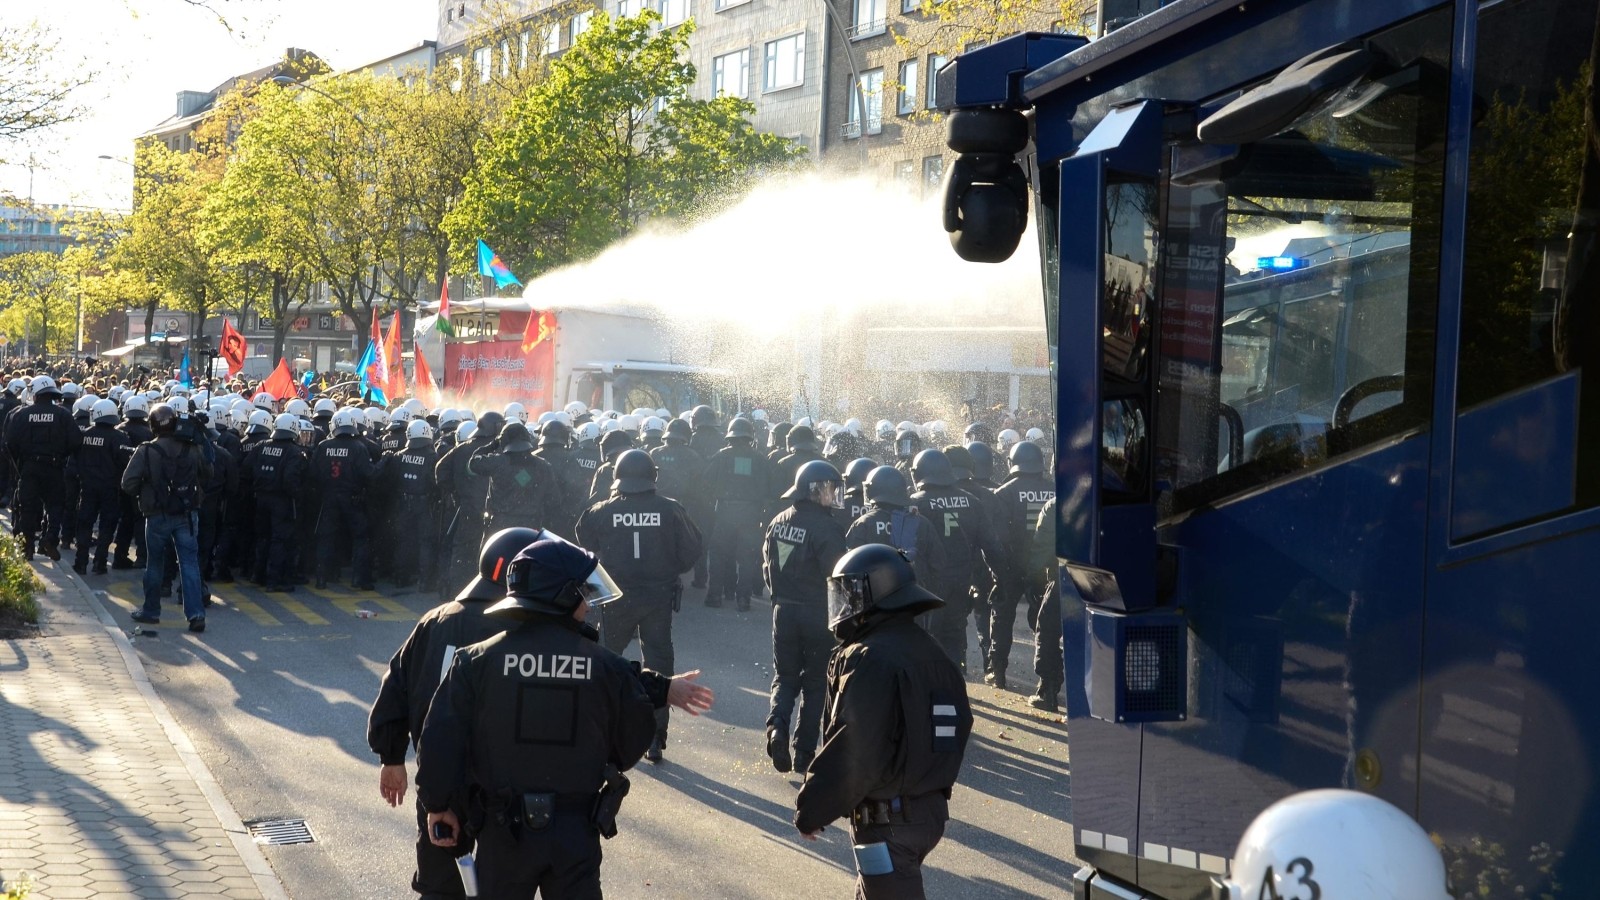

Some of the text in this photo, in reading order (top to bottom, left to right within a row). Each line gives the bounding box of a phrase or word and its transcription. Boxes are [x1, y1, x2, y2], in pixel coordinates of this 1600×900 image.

[29, 413, 54, 422] POLIZEI
[83, 436, 105, 446] POLIZEI
[262, 446, 283, 456] POLIZEI
[326, 448, 349, 457] POLIZEI
[401, 454, 425, 465] POLIZEI
[930, 496, 970, 509] POLIZEI
[613, 512, 661, 527] POLIZEI
[773, 523, 807, 544] POLIZEI
[503, 653, 592, 680] POLIZEI
[1258, 856, 1322, 900] 43
